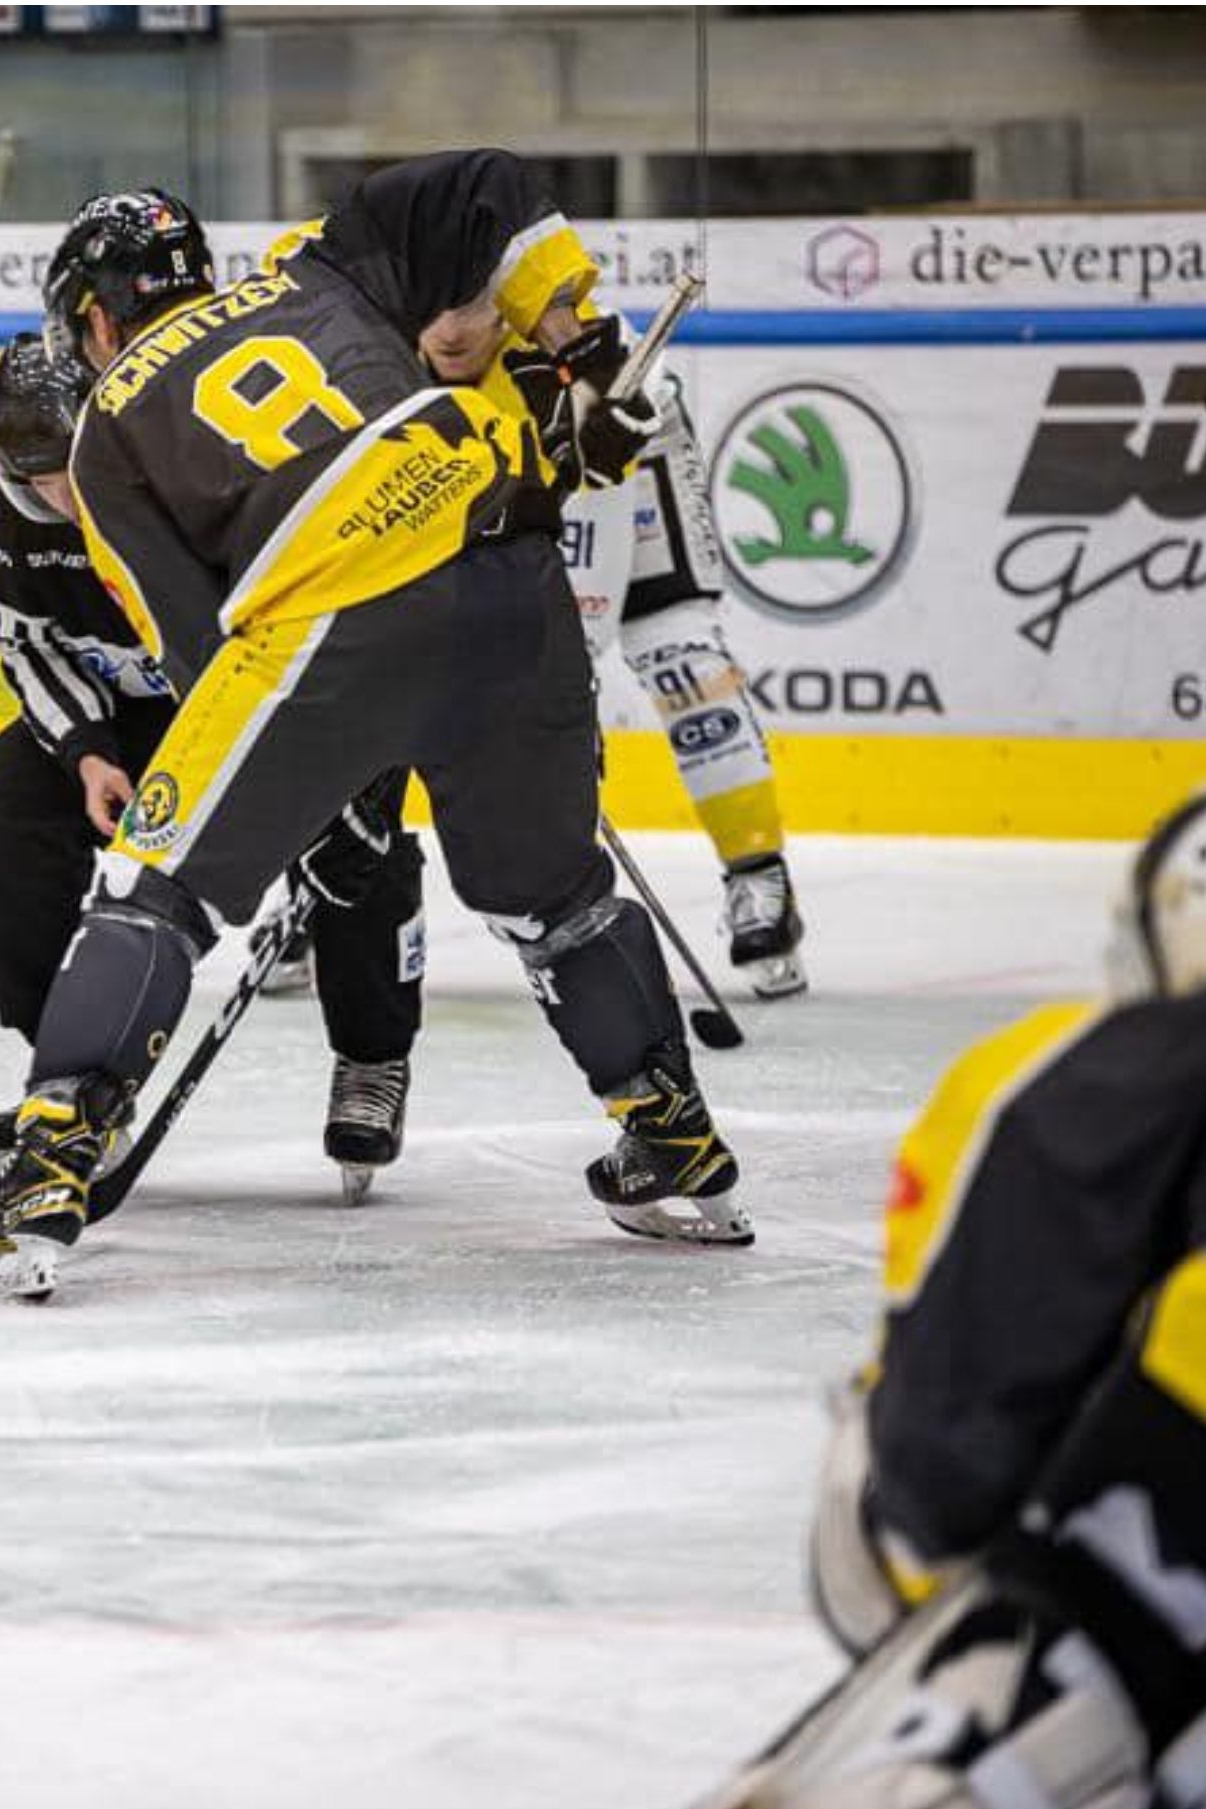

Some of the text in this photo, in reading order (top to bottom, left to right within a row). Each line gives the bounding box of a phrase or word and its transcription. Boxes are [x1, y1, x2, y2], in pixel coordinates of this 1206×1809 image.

[192, 335, 365, 471] 8
[654, 662, 706, 712] 91
[750, 670, 945, 714] KODA
